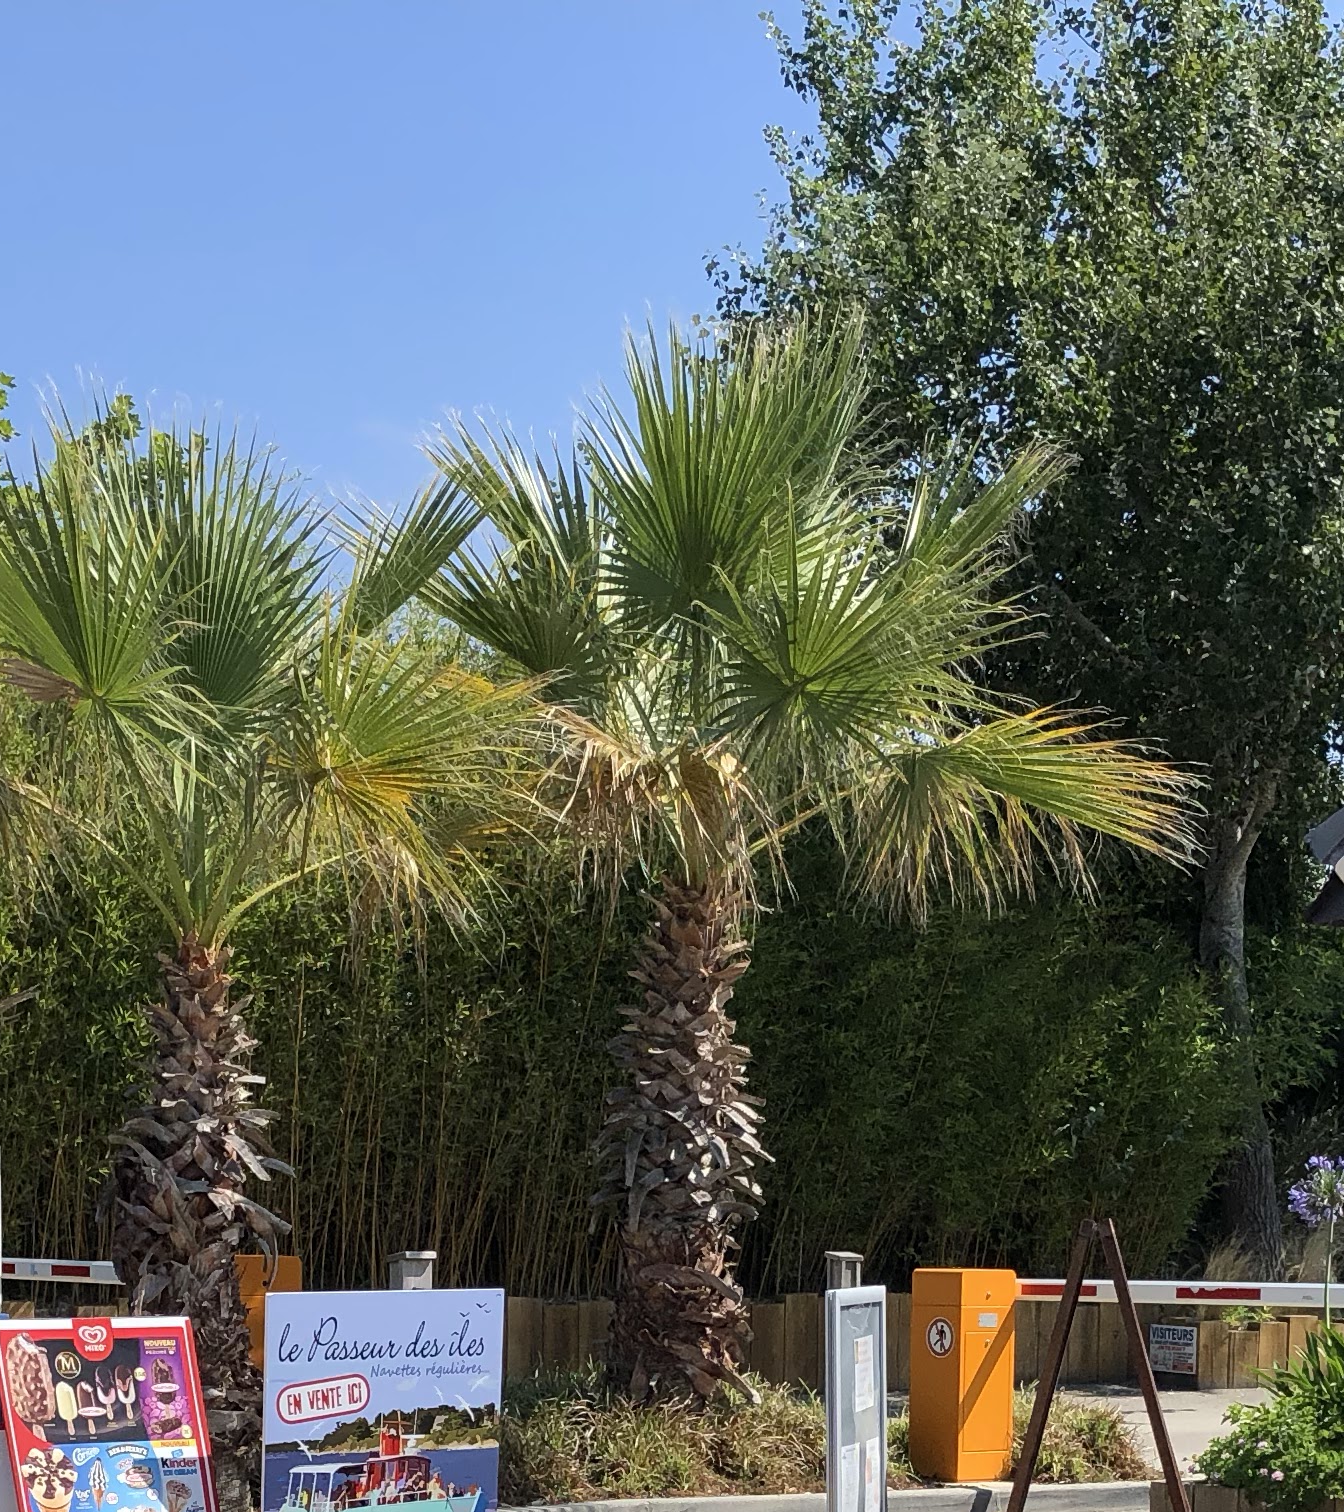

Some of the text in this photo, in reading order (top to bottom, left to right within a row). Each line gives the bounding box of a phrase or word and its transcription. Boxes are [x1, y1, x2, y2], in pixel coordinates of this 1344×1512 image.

[277, 1322, 304, 1363] le
[307, 1315, 403, 1363] Passeur
[404, 1320, 445, 1359] des
[1151, 1326, 1195, 1342] VISITEURS
[84, 1344, 106, 1353] MIKO
[370, 1362, 422, 1378] Navettes
[286, 1382, 363, 1416] EN VENTE ICI
